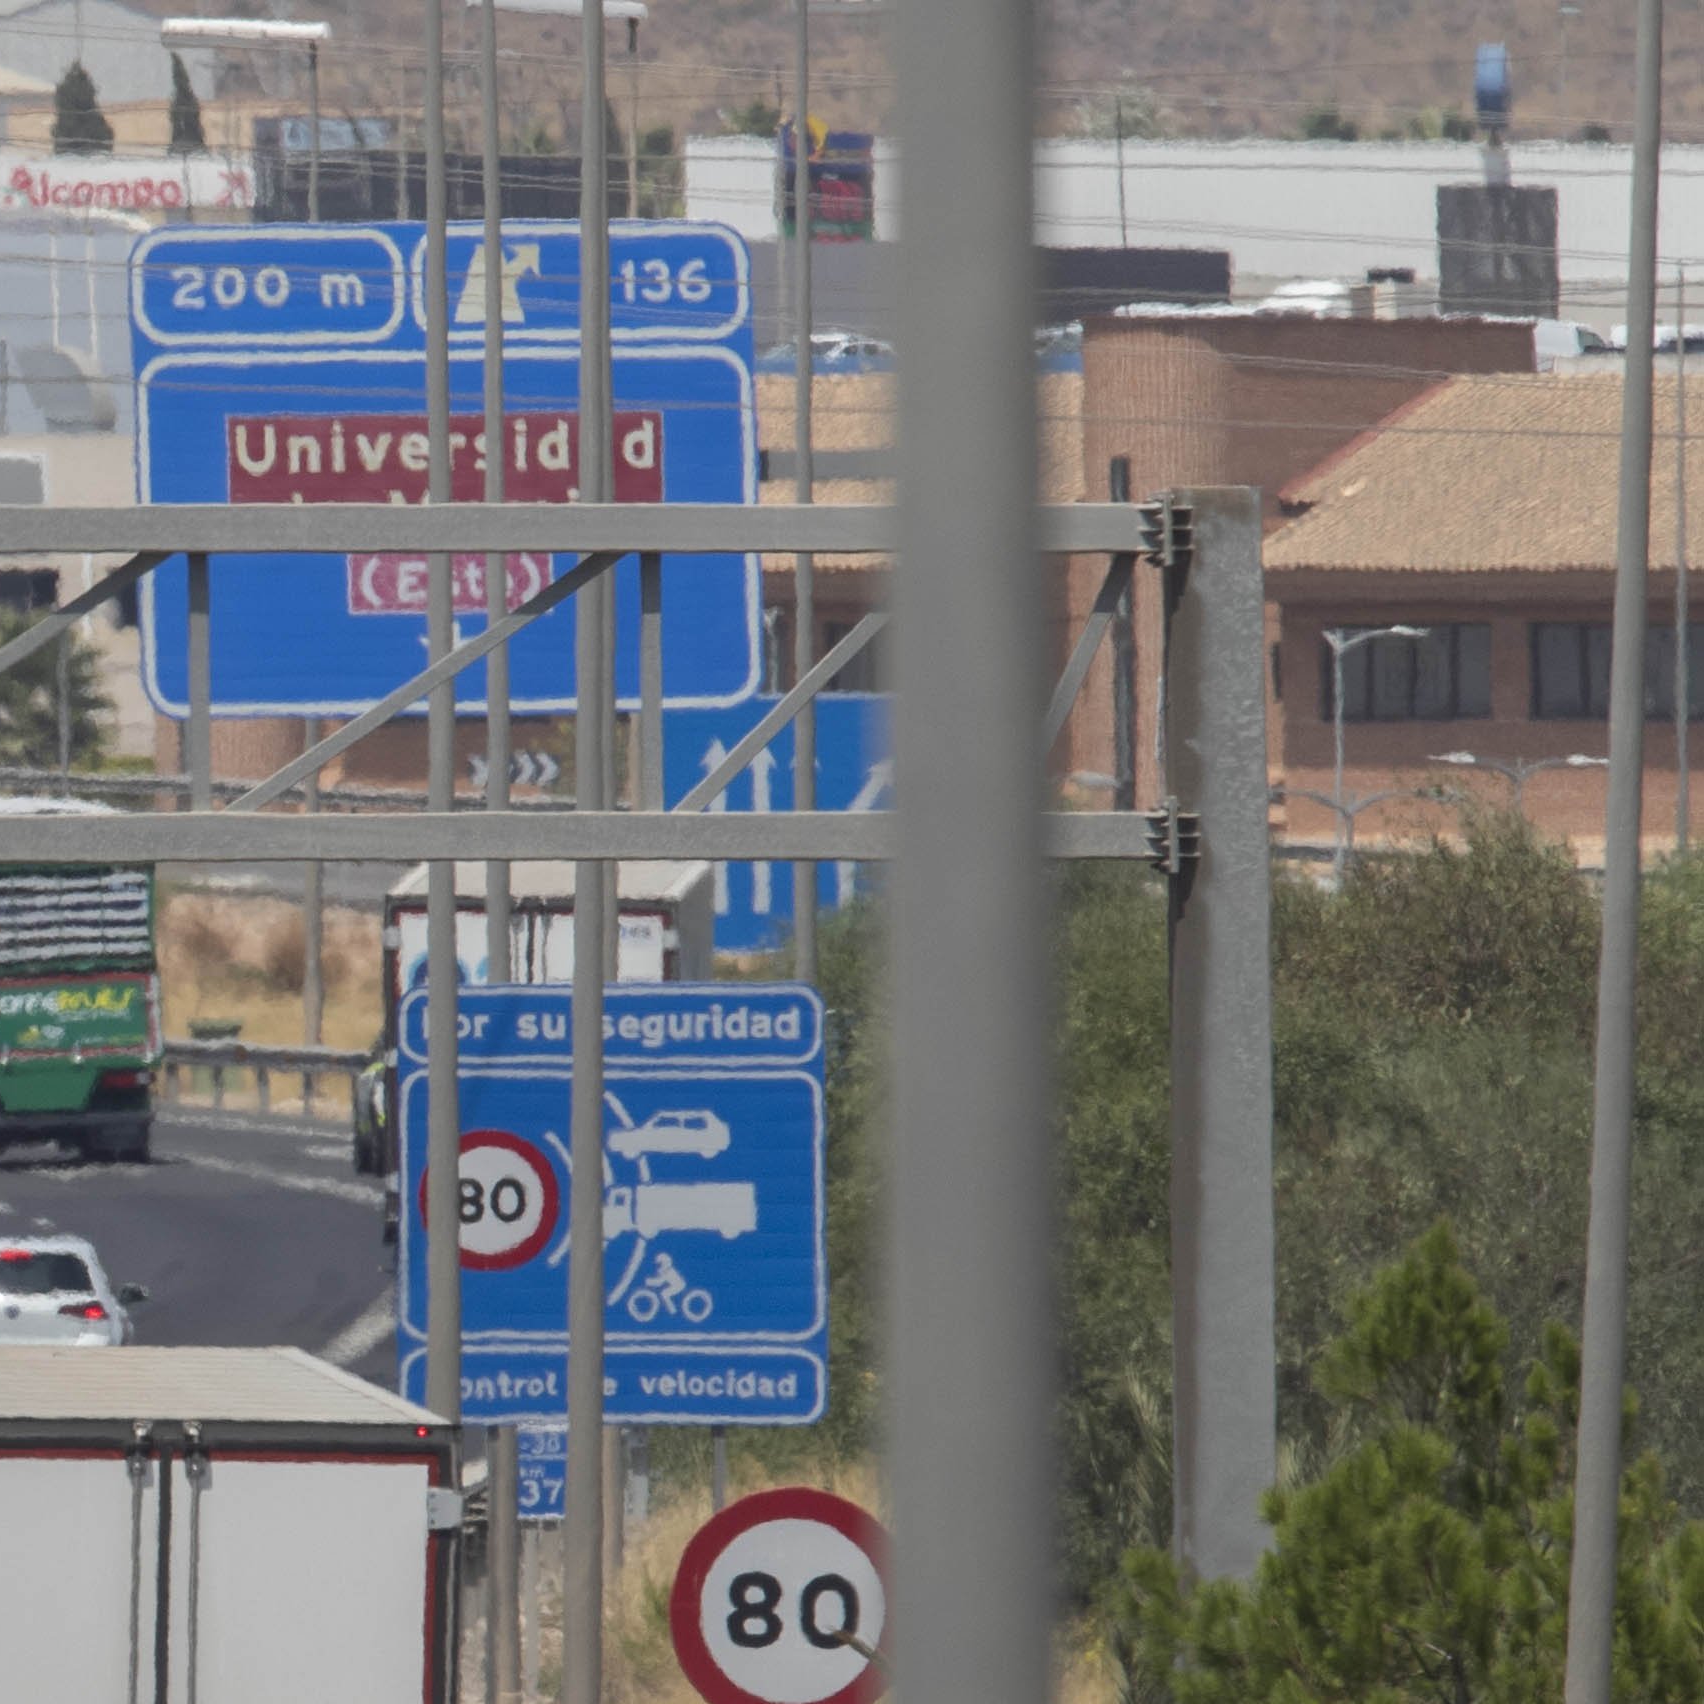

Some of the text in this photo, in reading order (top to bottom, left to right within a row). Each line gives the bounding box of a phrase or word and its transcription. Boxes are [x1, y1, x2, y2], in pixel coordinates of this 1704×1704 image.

[172, 265, 366, 308] 200 m
[619, 258, 713, 304] 136
[235, 419, 655, 476] Universidd
[515, 1011, 566, 1039] su
[601, 1003, 801, 1047] seguridad
[458, 1177, 526, 1223] 80
[459, 1370, 558, 1400] ontrol
[639, 1369, 799, 1398] velocidad
[519, 1479, 563, 1508] 37
[725, 1570, 861, 1651] 80
